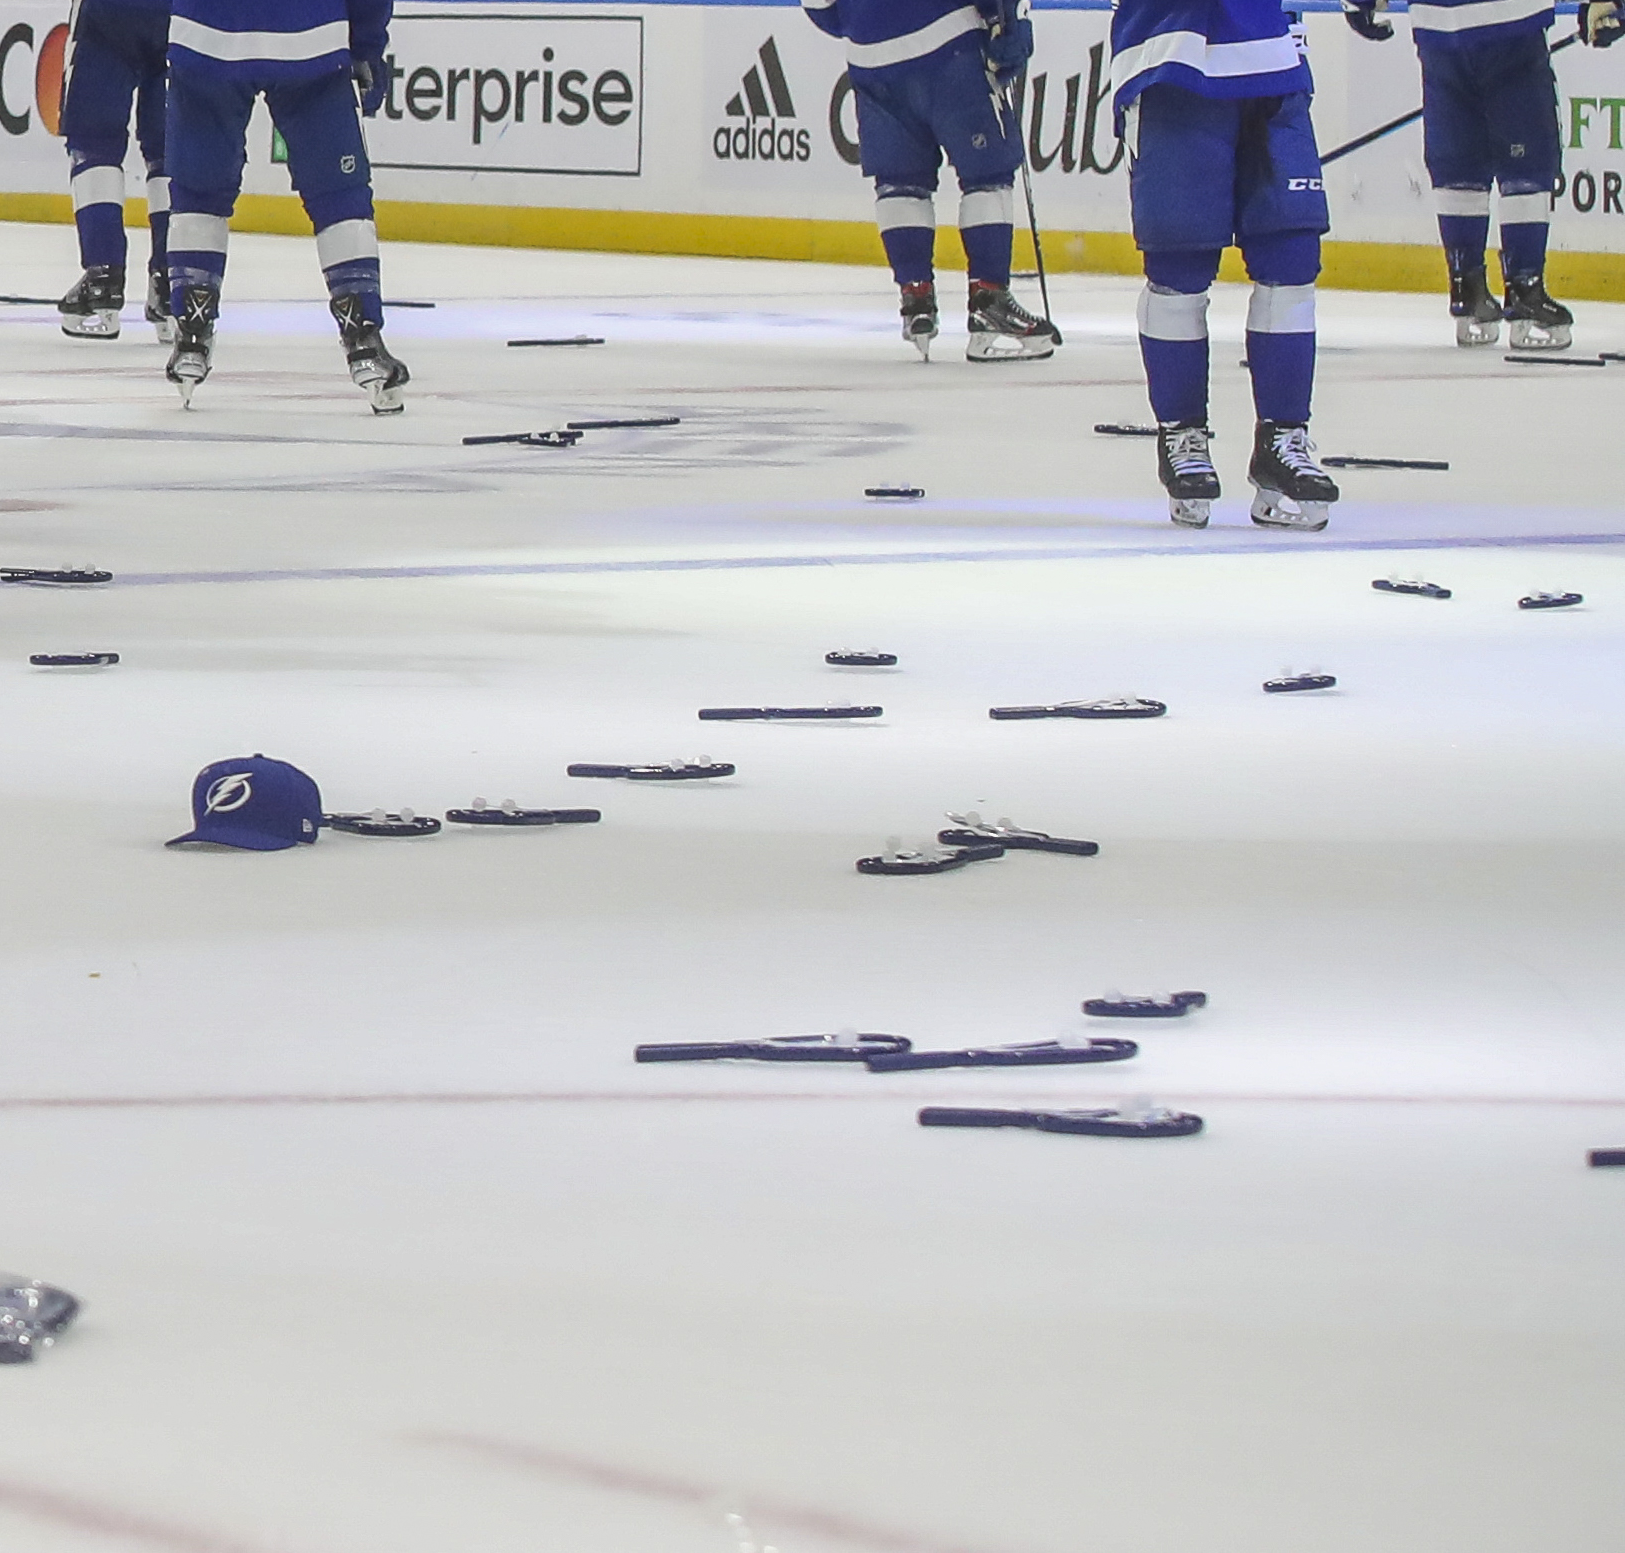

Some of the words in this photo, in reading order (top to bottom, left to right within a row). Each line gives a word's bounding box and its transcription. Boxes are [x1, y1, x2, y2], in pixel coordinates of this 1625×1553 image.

[383, 46, 634, 146] terprise
[712, 116, 812, 162] adidas
[1287, 177, 1324, 192] CC
